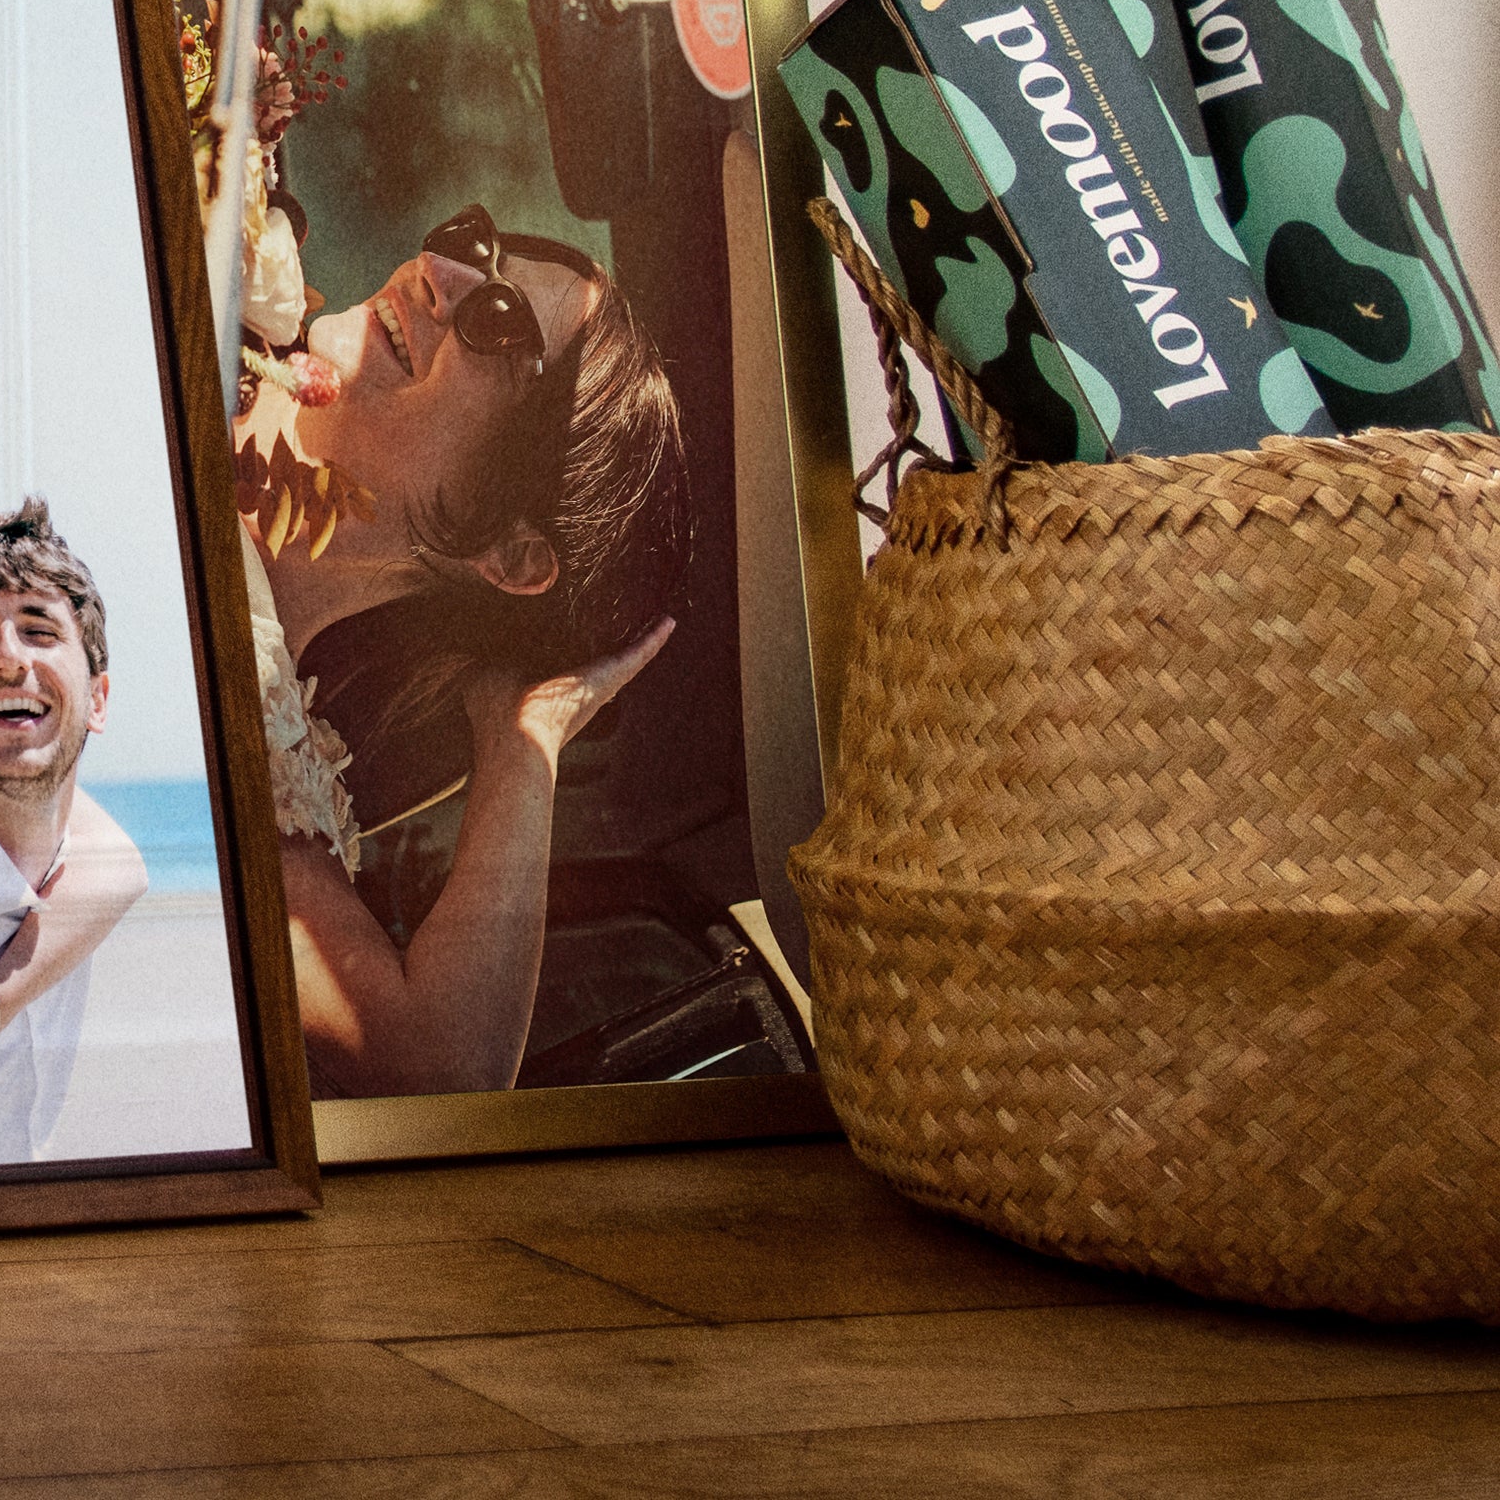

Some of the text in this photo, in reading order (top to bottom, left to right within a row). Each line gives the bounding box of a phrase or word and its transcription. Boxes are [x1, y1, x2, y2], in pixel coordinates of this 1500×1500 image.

[1078, 62, 1124, 140] beaucoup
[1118, 140, 1144, 177] with
[961, 5, 1225, 411] Lovemood
[1140, 179, 1169, 222] made
